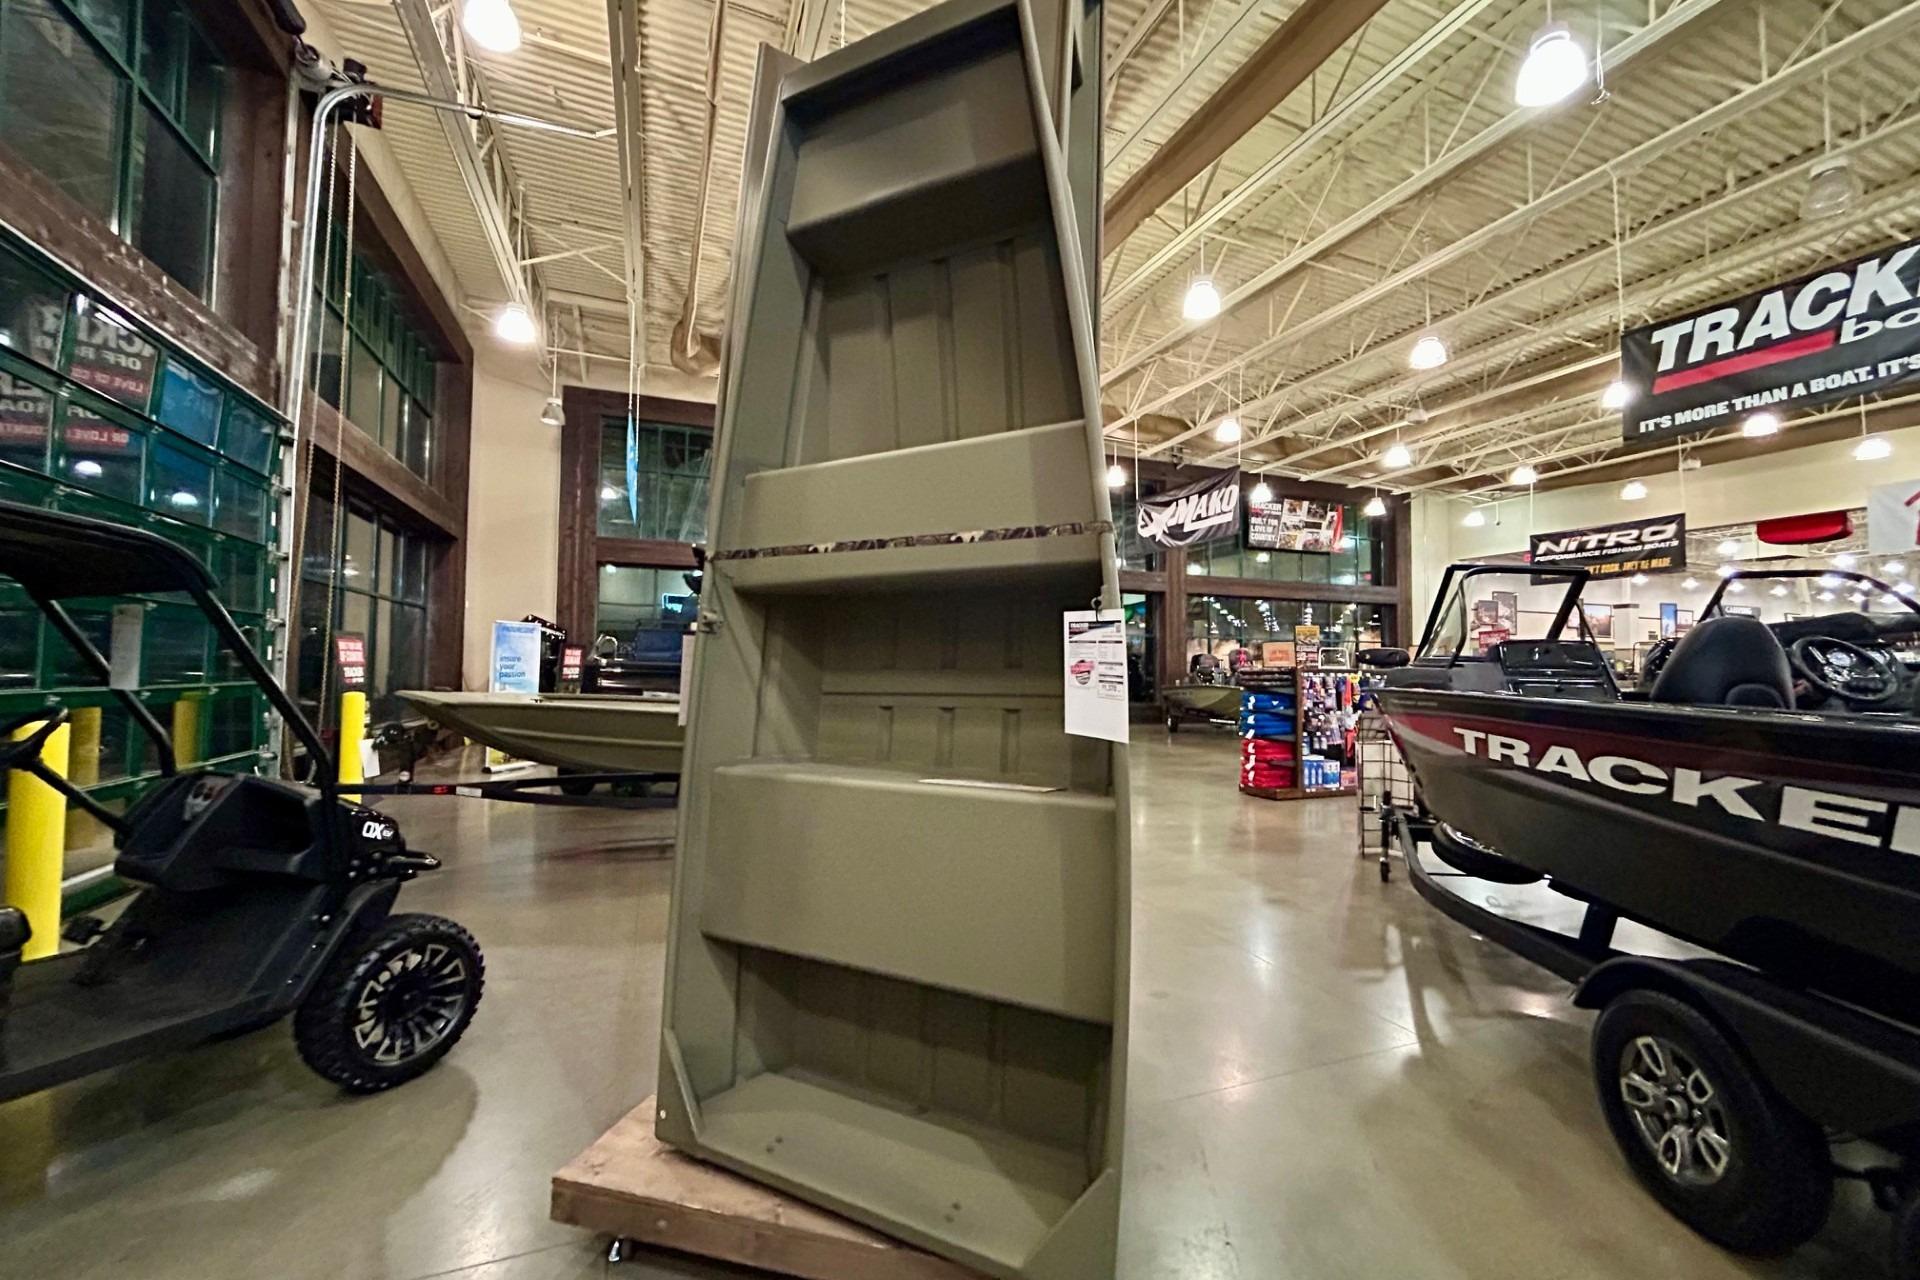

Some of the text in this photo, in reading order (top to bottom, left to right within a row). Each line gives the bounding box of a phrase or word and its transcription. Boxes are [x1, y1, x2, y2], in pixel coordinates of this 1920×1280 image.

[1651, 245, 1920, 372] TRACK
[1639, 415, 1673, 433] IT'S
[1675, 401, 1729, 425] MORE
[1731, 386, 1788, 411] THAN
[1791, 382, 1807, 397] A
[1810, 367, 1873, 393] BOAT.
[1168, 484, 1239, 531] MAKO
[1534, 551, 1600, 562] PERFORMANCE
[1602, 545, 1642, 556] FISHING
[1644, 539, 1679, 551] BOATS
[499, 671, 526, 680] passion
